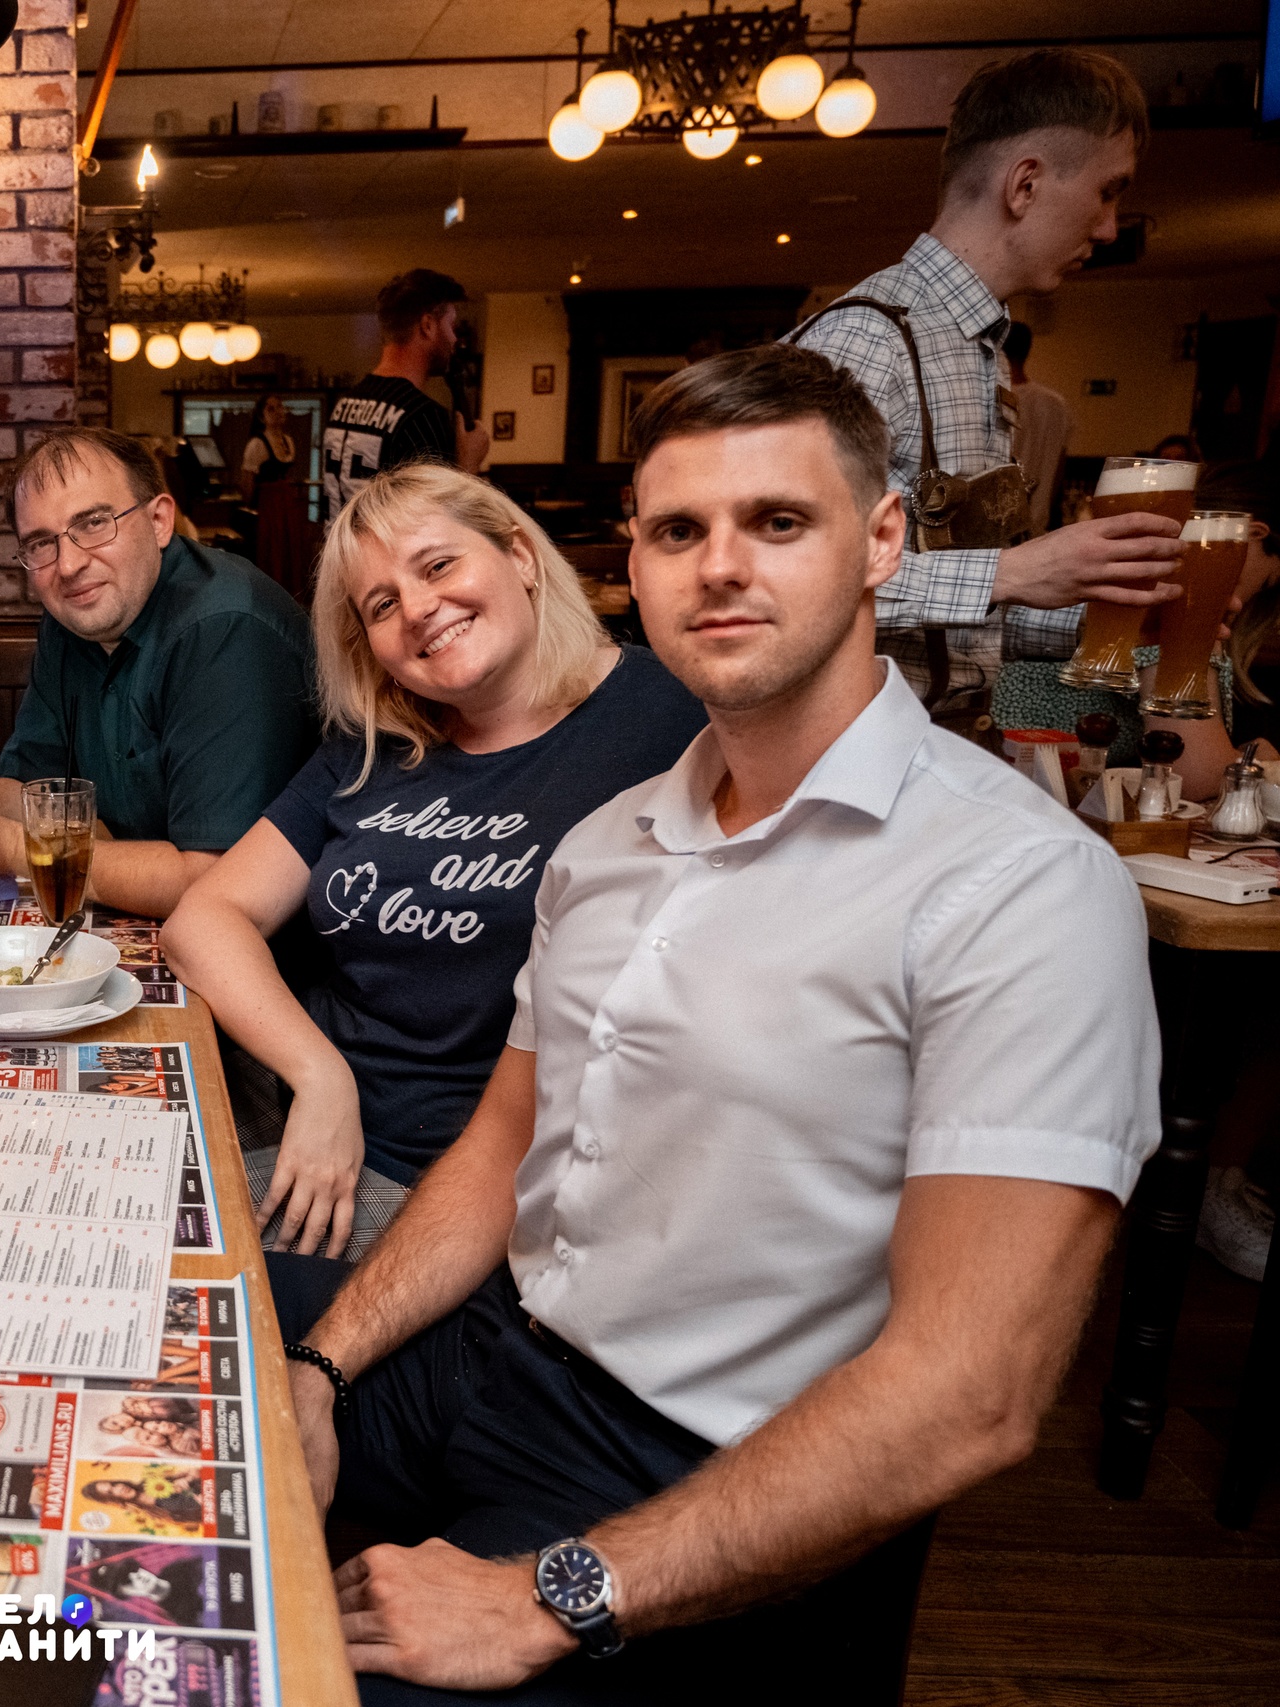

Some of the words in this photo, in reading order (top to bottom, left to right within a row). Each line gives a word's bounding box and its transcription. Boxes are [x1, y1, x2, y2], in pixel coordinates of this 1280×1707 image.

[356, 797, 529, 840] believe
[430, 844, 540, 892] and
[378, 887, 485, 944] love
[218, 1299, 228, 1324] МИРАЖ
[220, 1357, 231, 1379] СВЕТА
[201, 1409, 210, 1443] СЕНТЯБРЯ
[215, 1399, 227, 1428] СОСТАВ
[44, 1402, 75, 1518] MAXIMILIANS.RU
[217, 1429, 230, 1461] ЗОЛОТОЙ
[221, 1489, 233, 1516] ДЕНЬ
[232, 1472, 246, 1536] ИМЕНИННИКА
